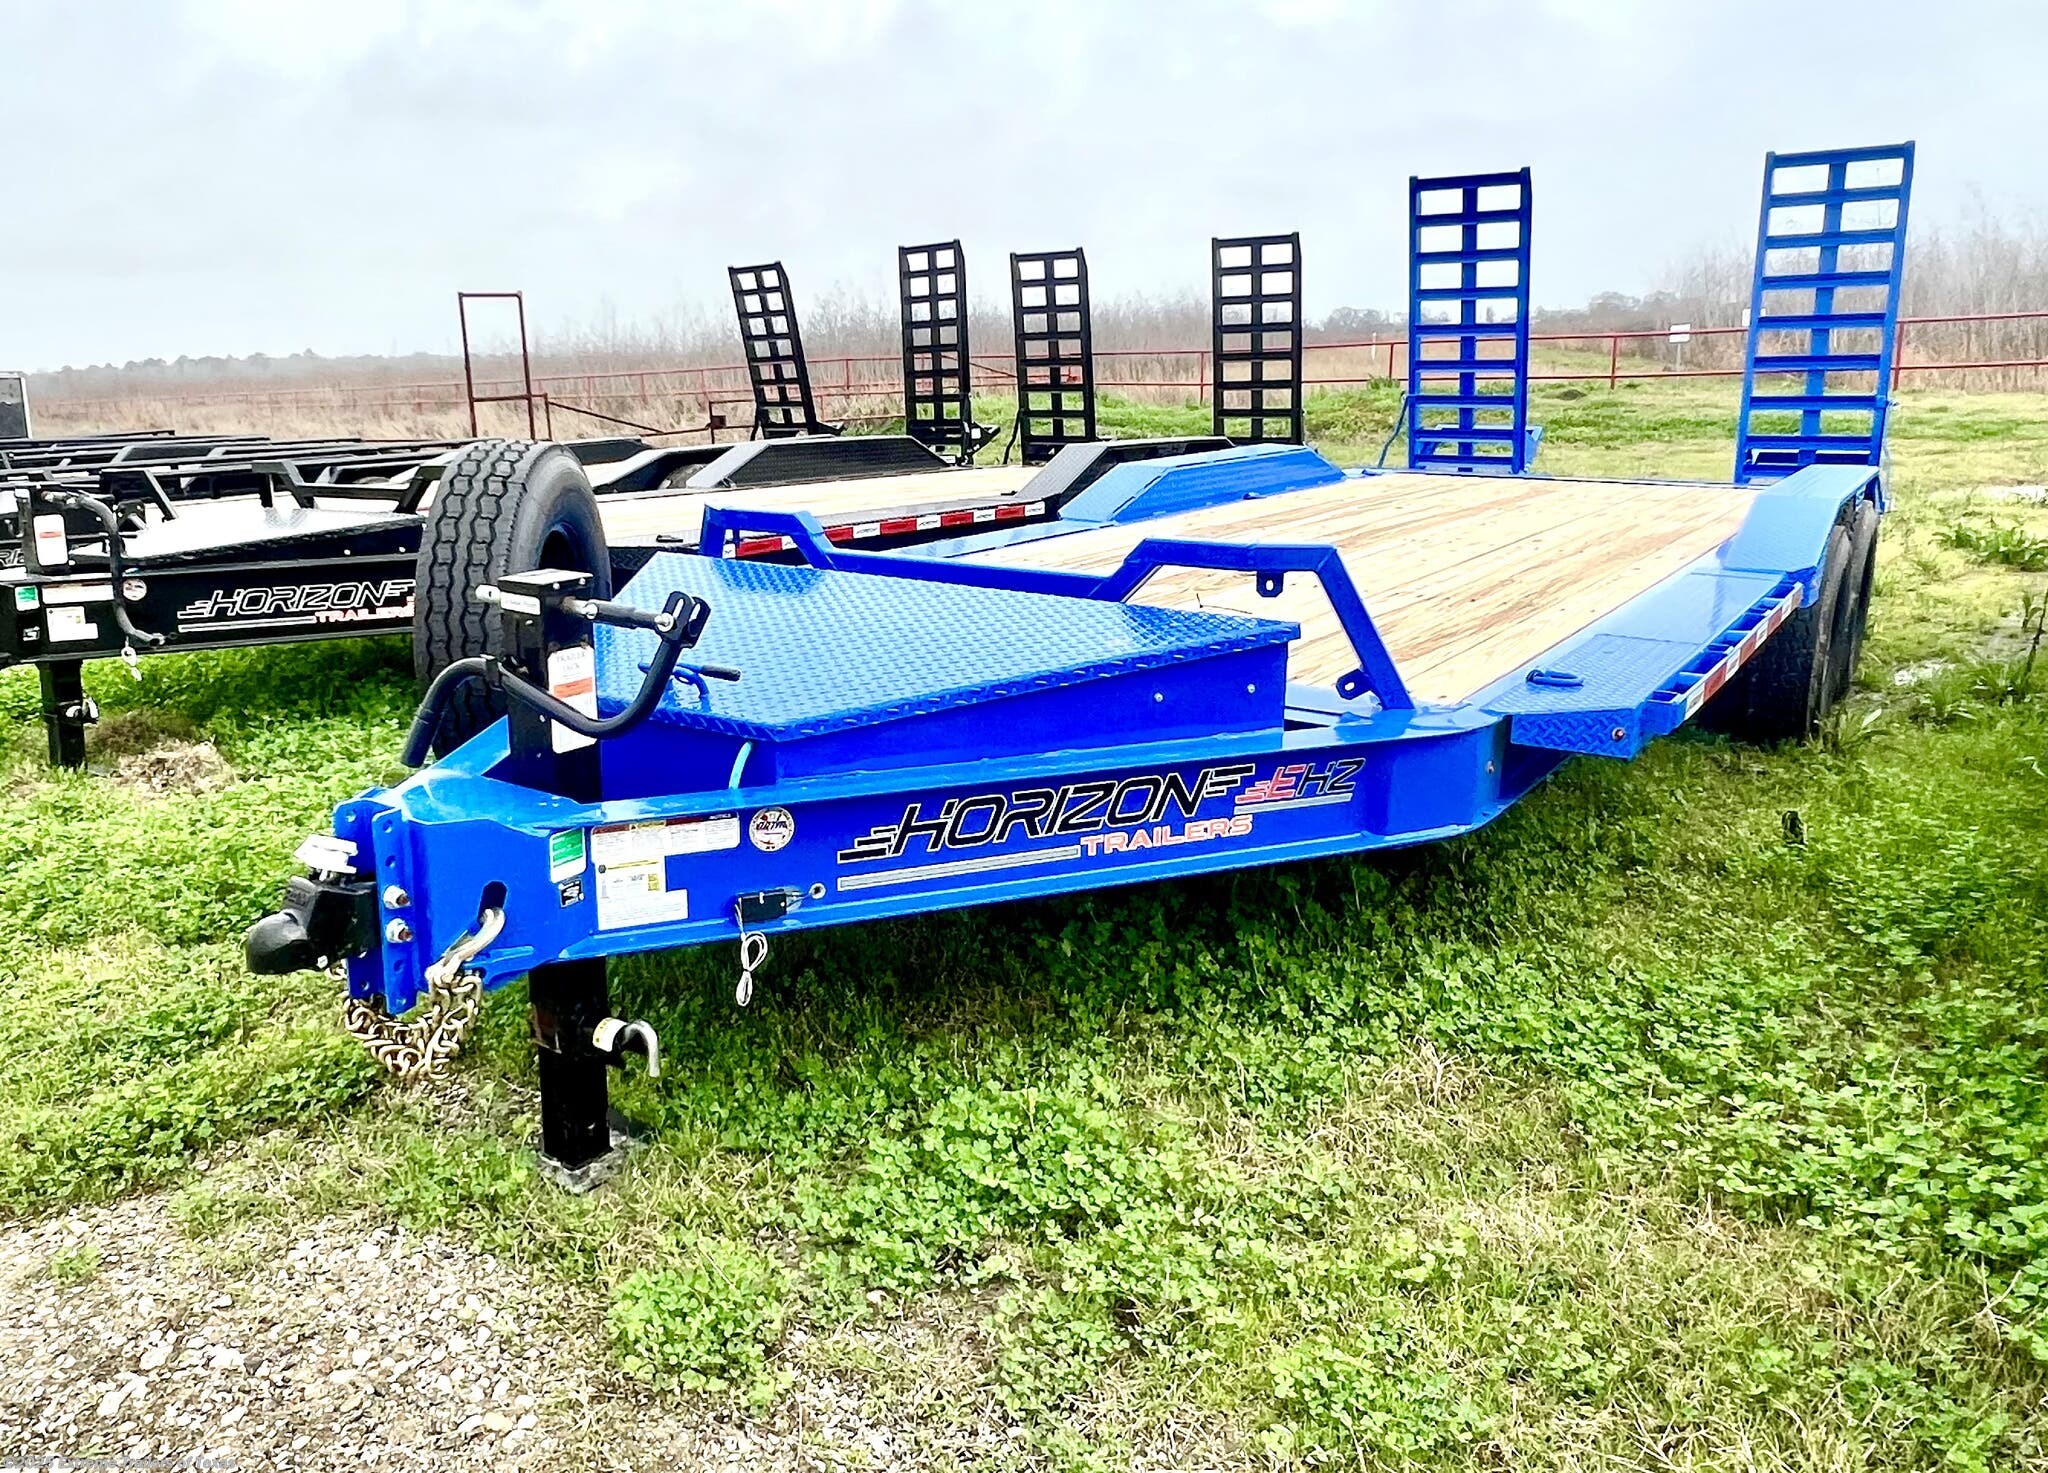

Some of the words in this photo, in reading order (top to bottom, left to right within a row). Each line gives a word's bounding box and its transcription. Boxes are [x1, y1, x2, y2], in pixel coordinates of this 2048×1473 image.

[208, 580, 389, 617] HORIZON
[896, 770, 1206, 857] HORIZON
[1080, 817, 1253, 857] TRAILERS
